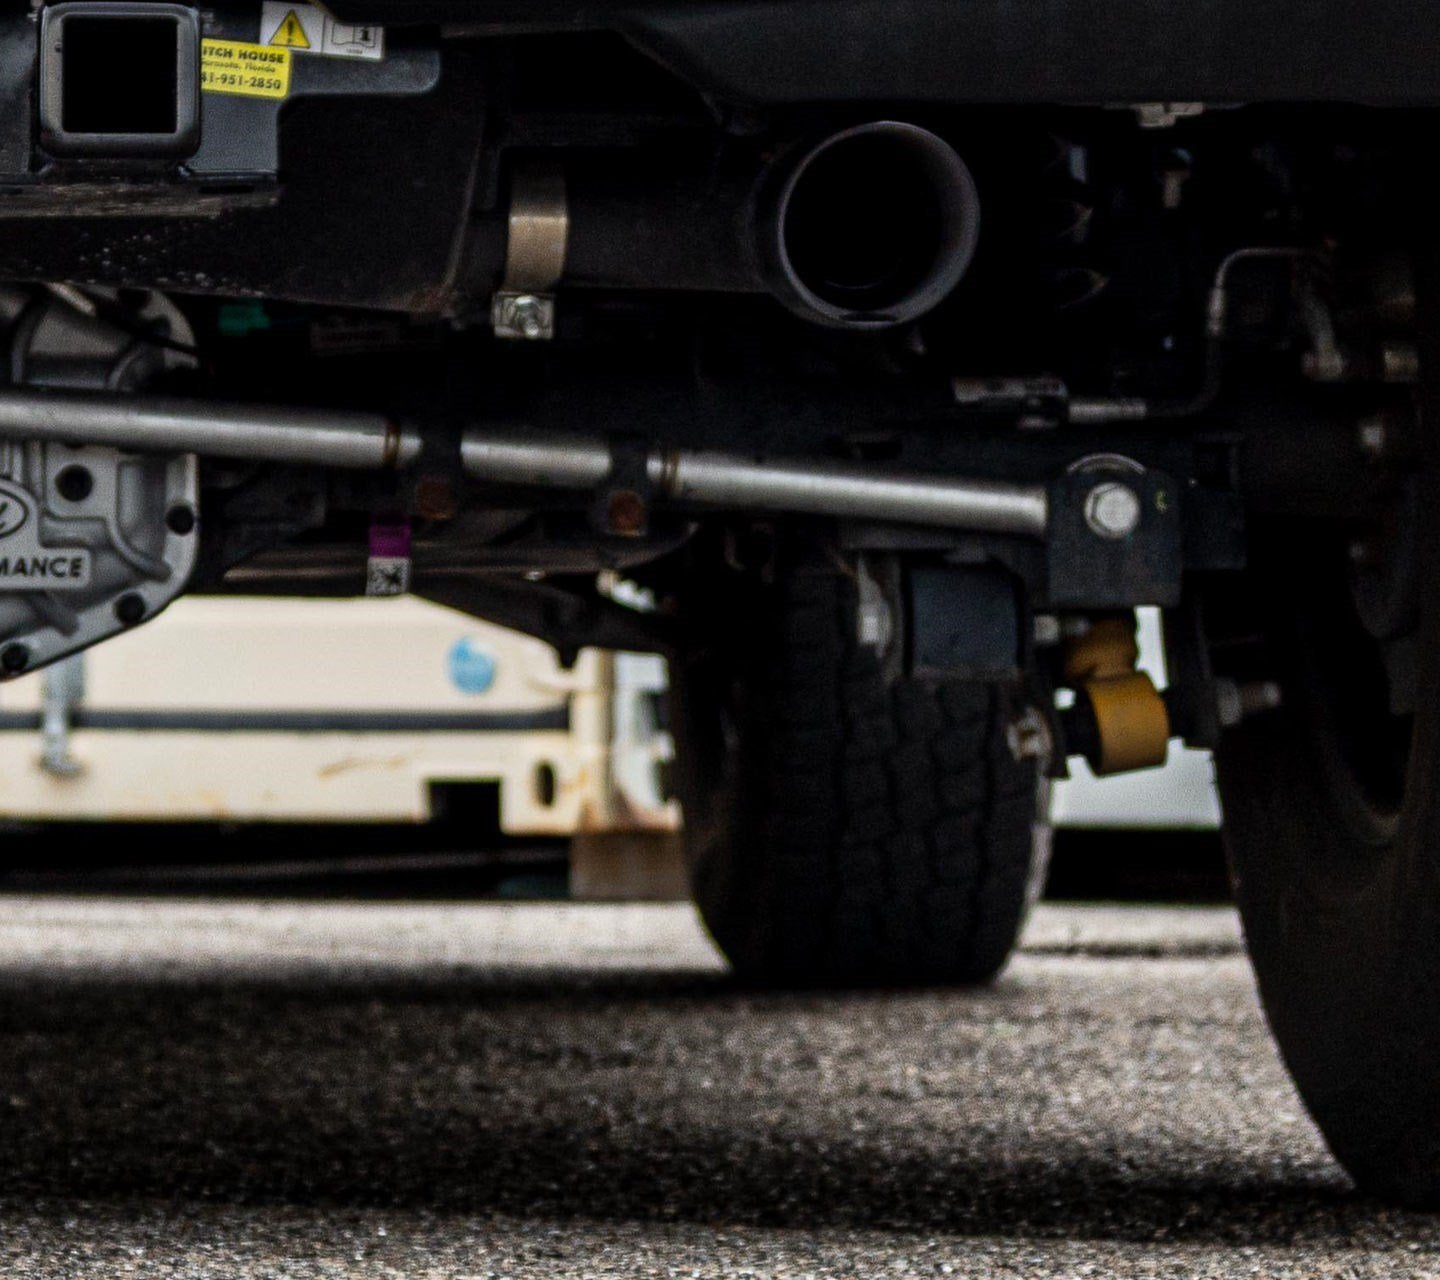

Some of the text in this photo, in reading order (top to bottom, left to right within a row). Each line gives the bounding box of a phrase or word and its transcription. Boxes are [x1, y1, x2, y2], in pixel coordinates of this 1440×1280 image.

[202, 46, 285, 64] ITCH HOUSE
[201, 70, 282, 90] 41-951-2850
